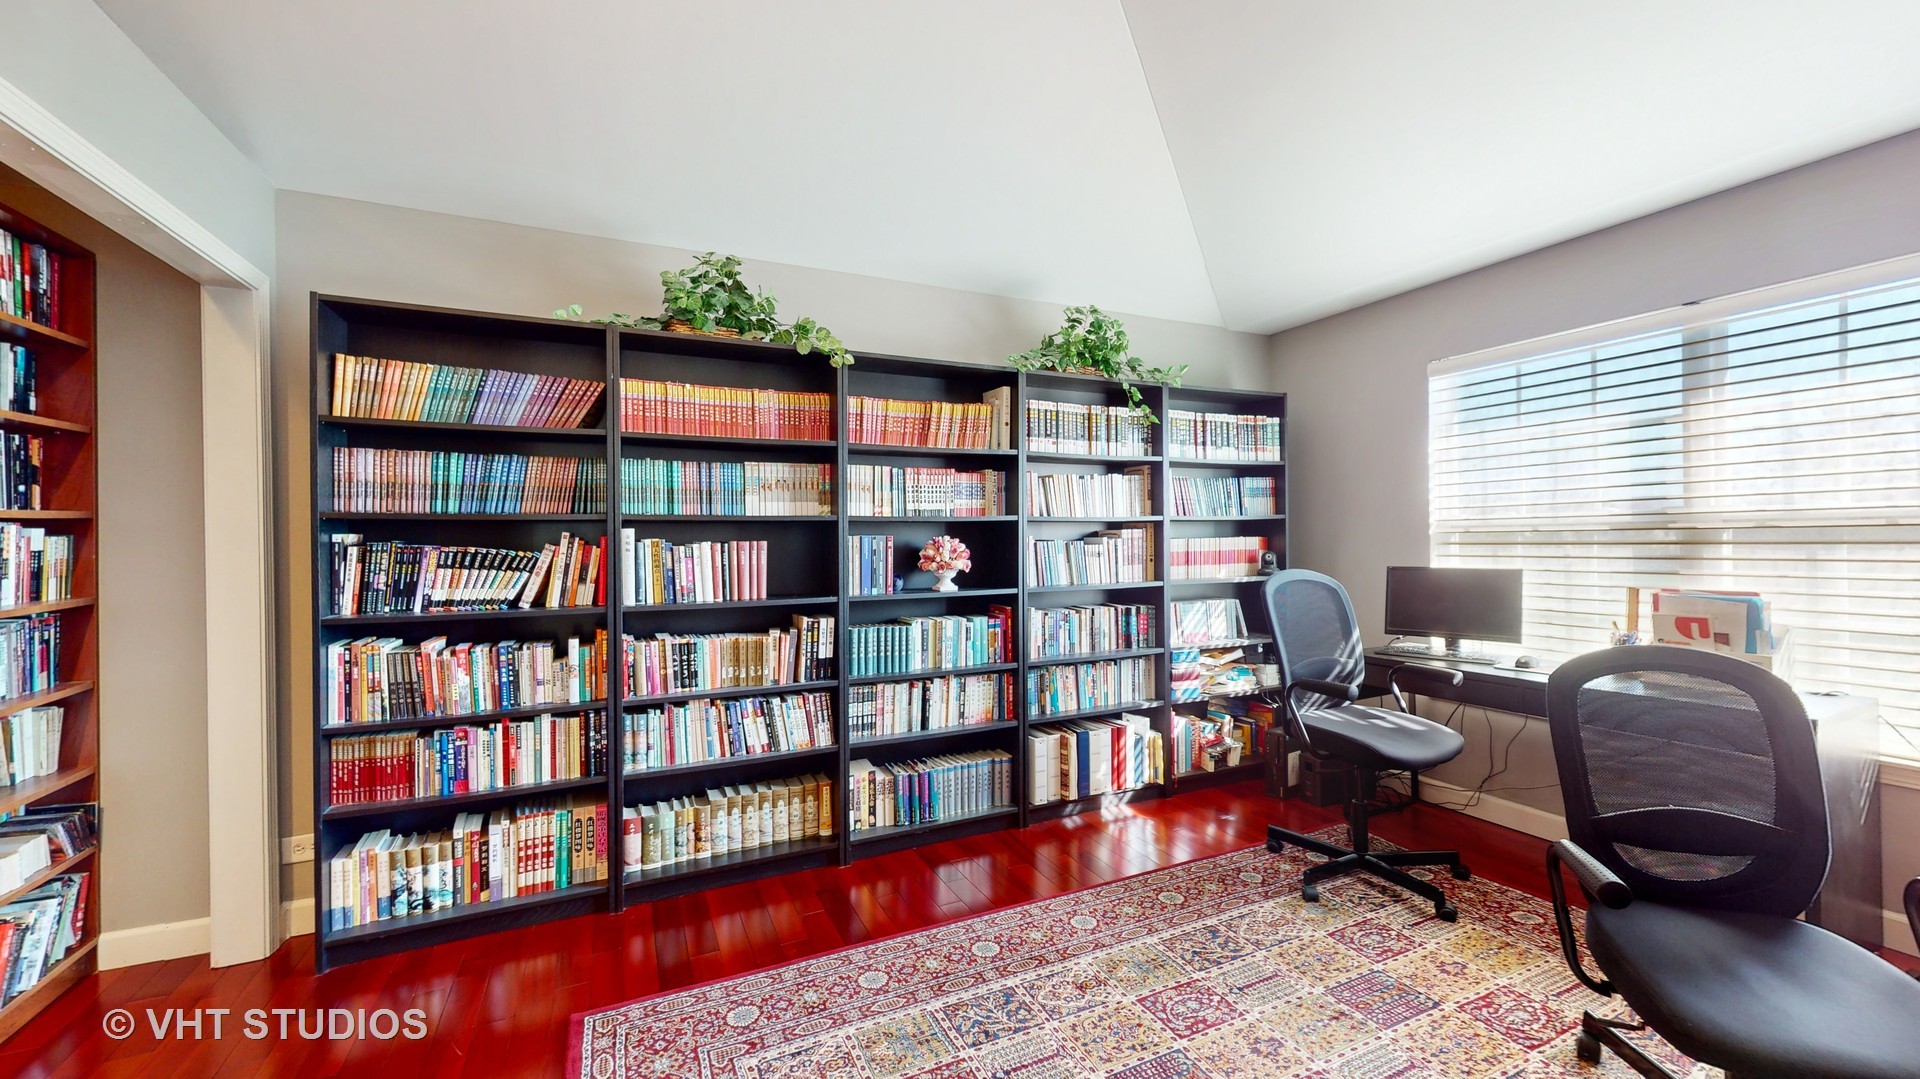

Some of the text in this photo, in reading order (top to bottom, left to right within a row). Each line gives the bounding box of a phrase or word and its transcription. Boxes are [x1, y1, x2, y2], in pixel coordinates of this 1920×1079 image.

[653, 548, 661, 574] 人性的弱点
